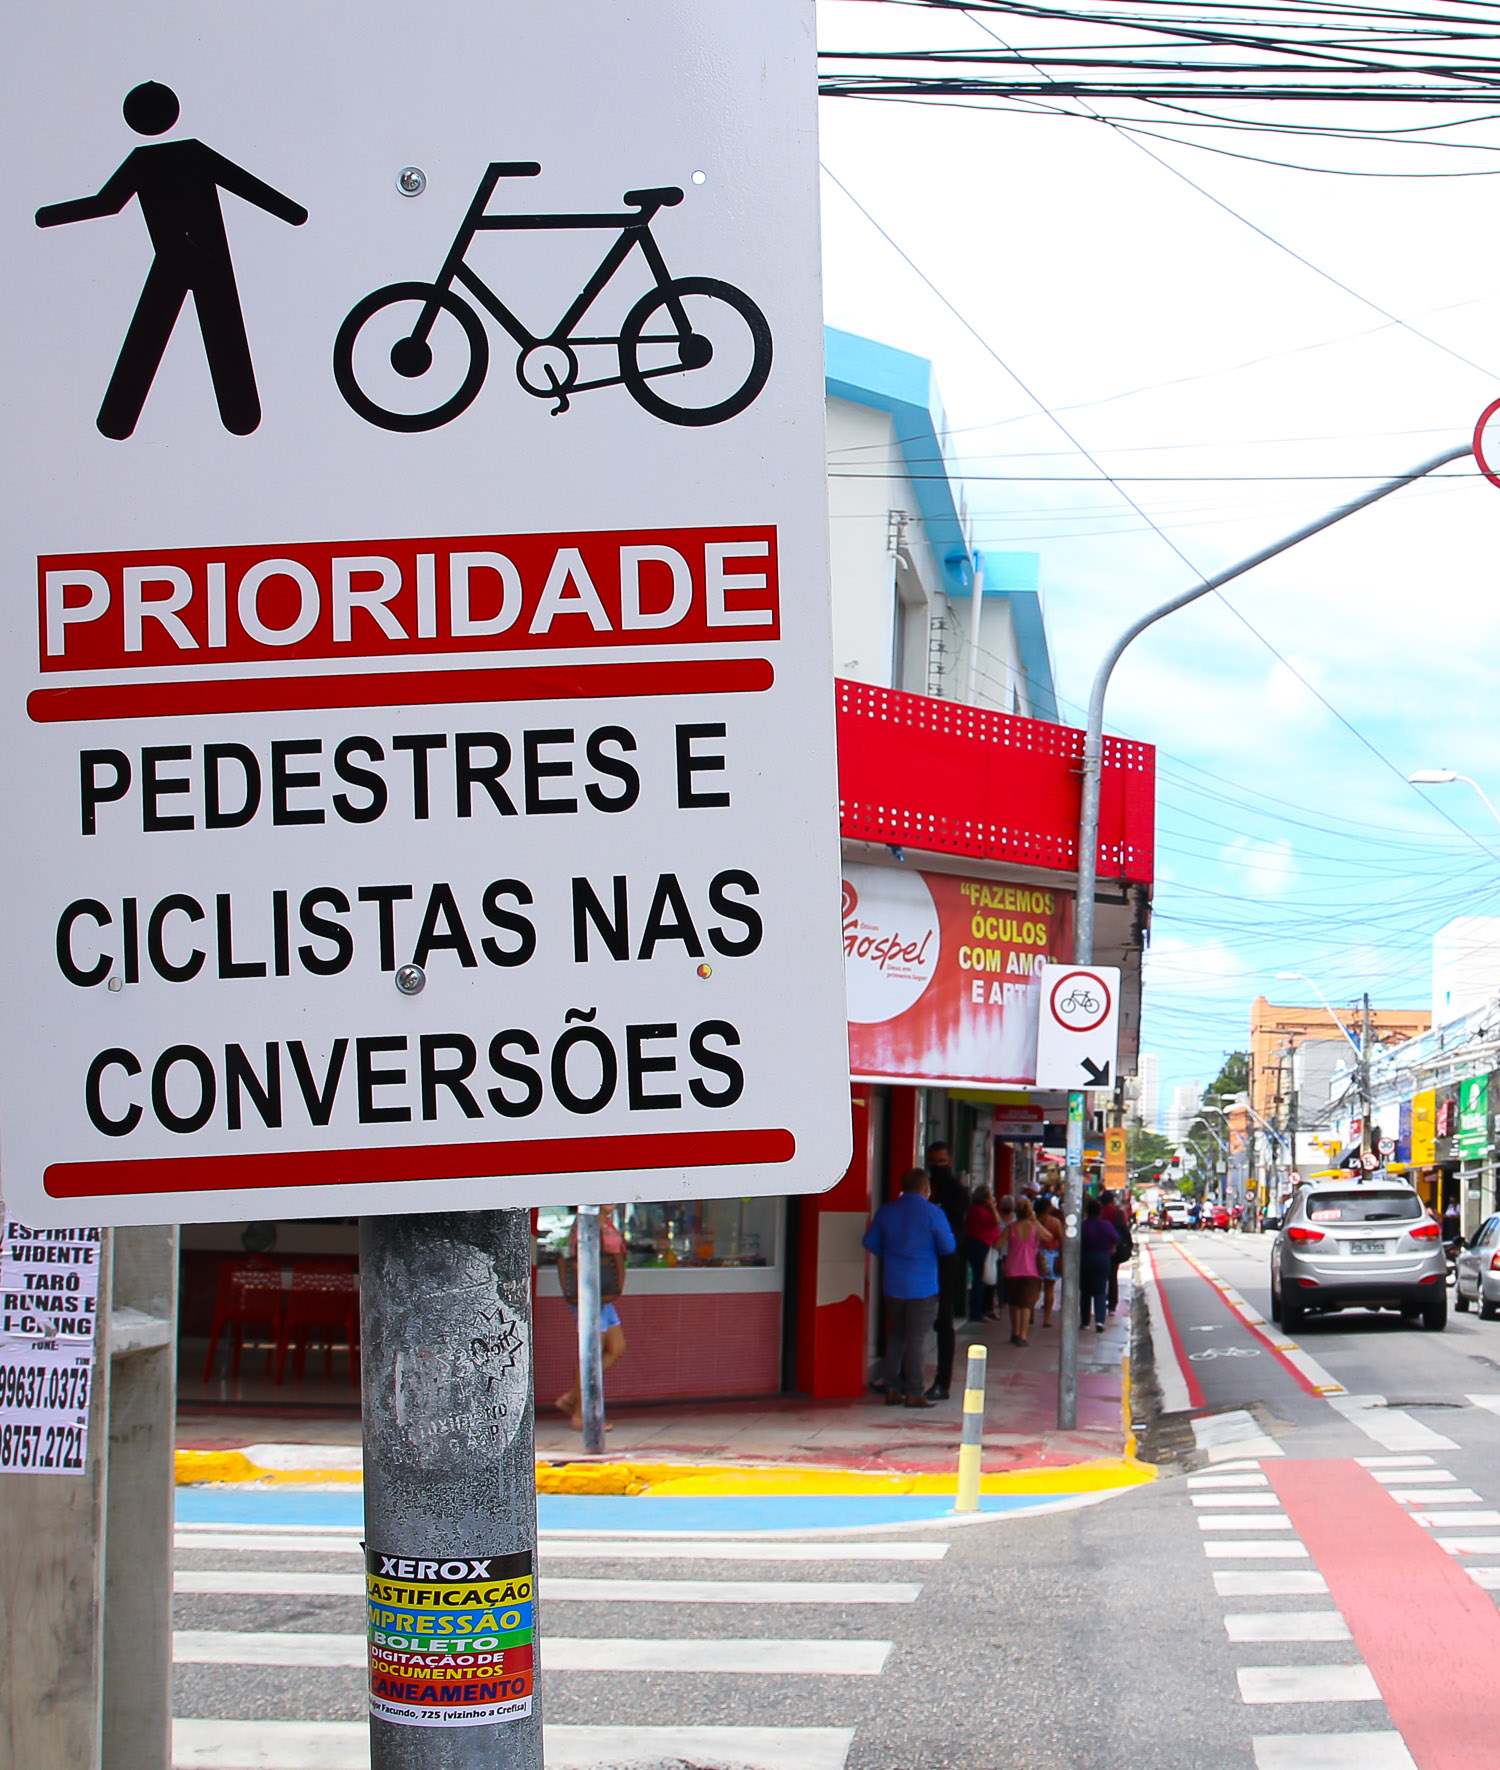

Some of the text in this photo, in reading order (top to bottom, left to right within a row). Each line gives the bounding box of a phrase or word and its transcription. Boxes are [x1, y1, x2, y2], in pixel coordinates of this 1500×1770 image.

[46, 540, 773, 656] PRIORIDADE
[79, 722, 731, 836] PEDESTRES E
[55, 867, 764, 988] CICLISTAS NAS
[971, 910, 1047, 947] ÓCULOS
[958, 945, 1001, 973] COM
[971, 979, 985, 1003] E
[84, 1005, 745, 1137] CONVERSÕES
[1380, 1141, 1393, 1149] 30
[11, 1245, 94, 1264] VIDENTE
[23, 1271, 80, 1292] TARÔ
[4, 1294, 95, 1313] RUNAS E
[0, 1424, 82, 1468] 8757.2721
[380, 1556, 492, 1580] XEROX
[374, 1631, 499, 1652] BOLETO
[371, 1646, 504, 1668] DIGITAÇÃO DE
[371, 1658, 504, 1680] DOCUMENTOS
[381, 1704, 418, 1719] Facundo,
[421, 1711, 441, 1719] 725
[443, 1709, 486, 1721] (vizinho
